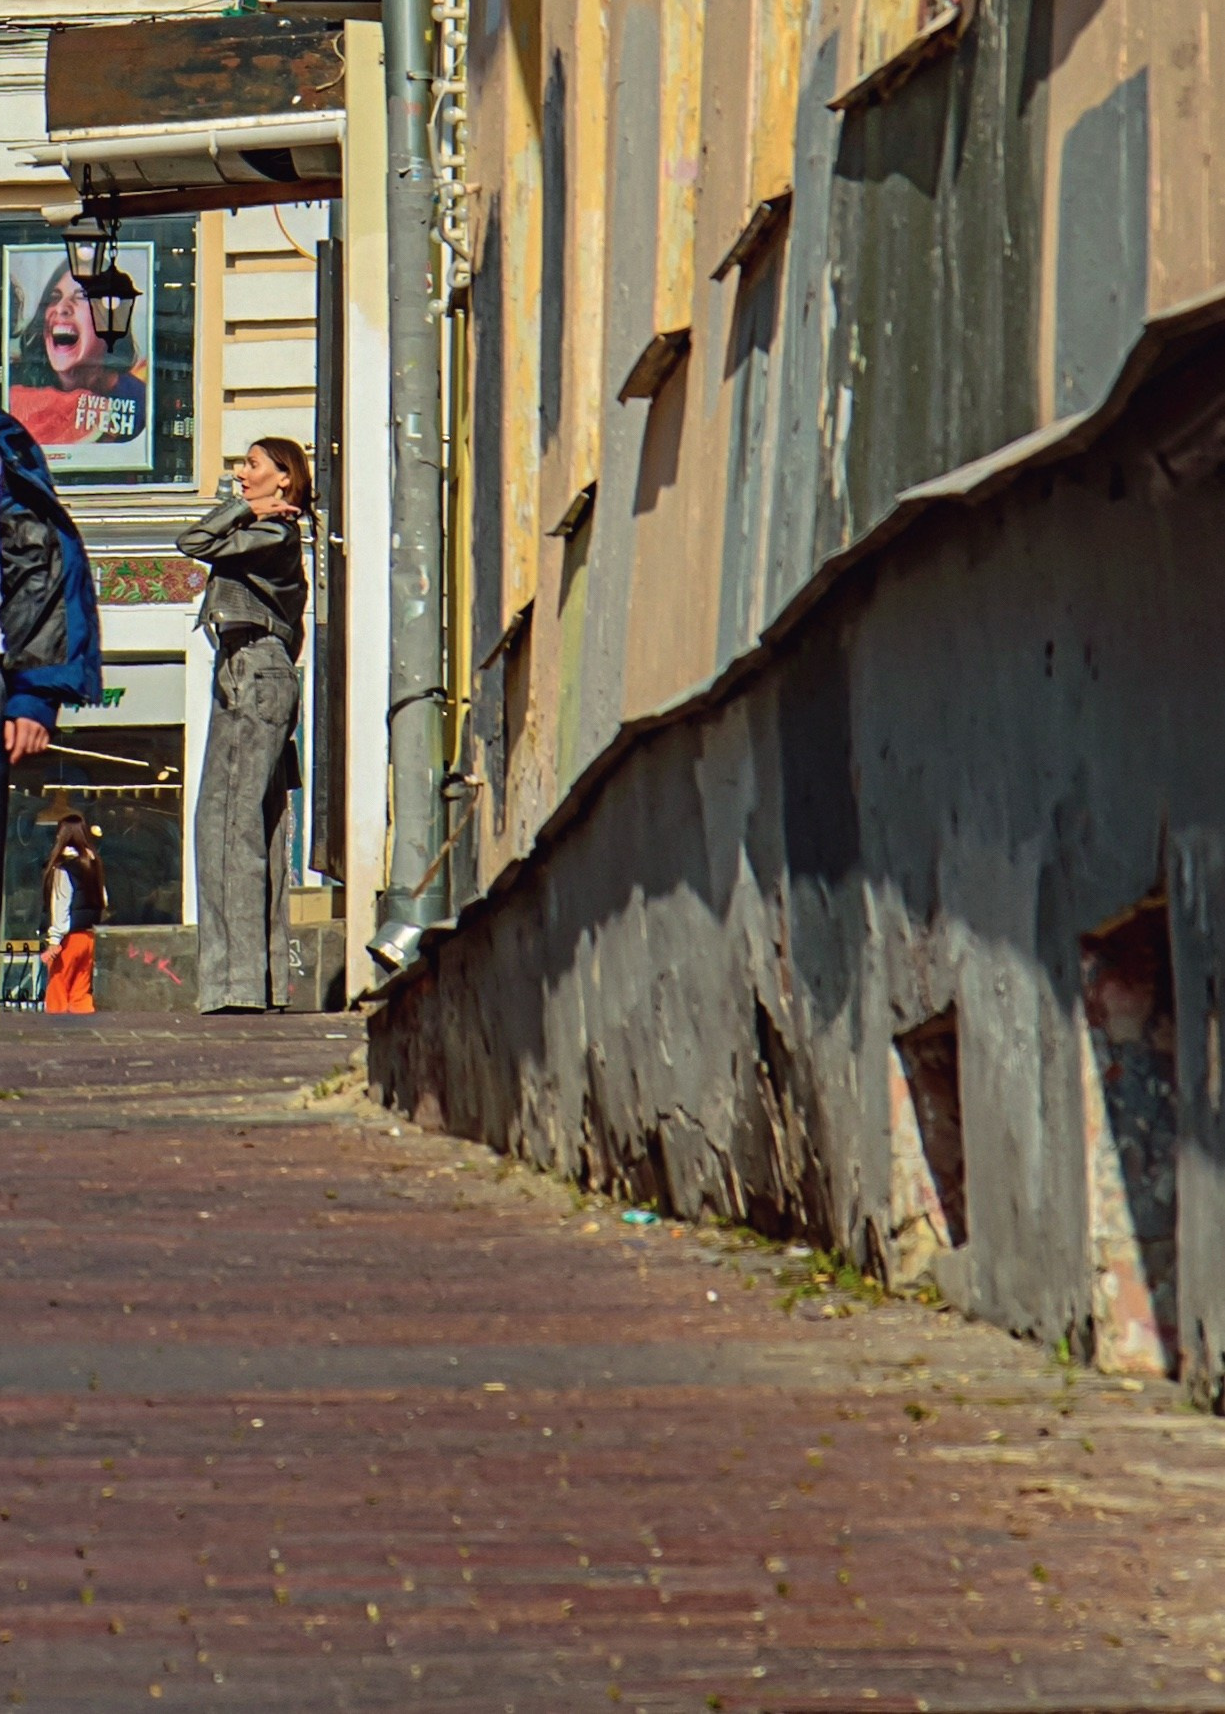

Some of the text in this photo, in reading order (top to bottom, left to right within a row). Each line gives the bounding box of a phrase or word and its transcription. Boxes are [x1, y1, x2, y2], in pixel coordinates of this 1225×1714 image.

[78, 393, 136, 414] #WE LOVE
[75, 408, 135, 435] FRESH
